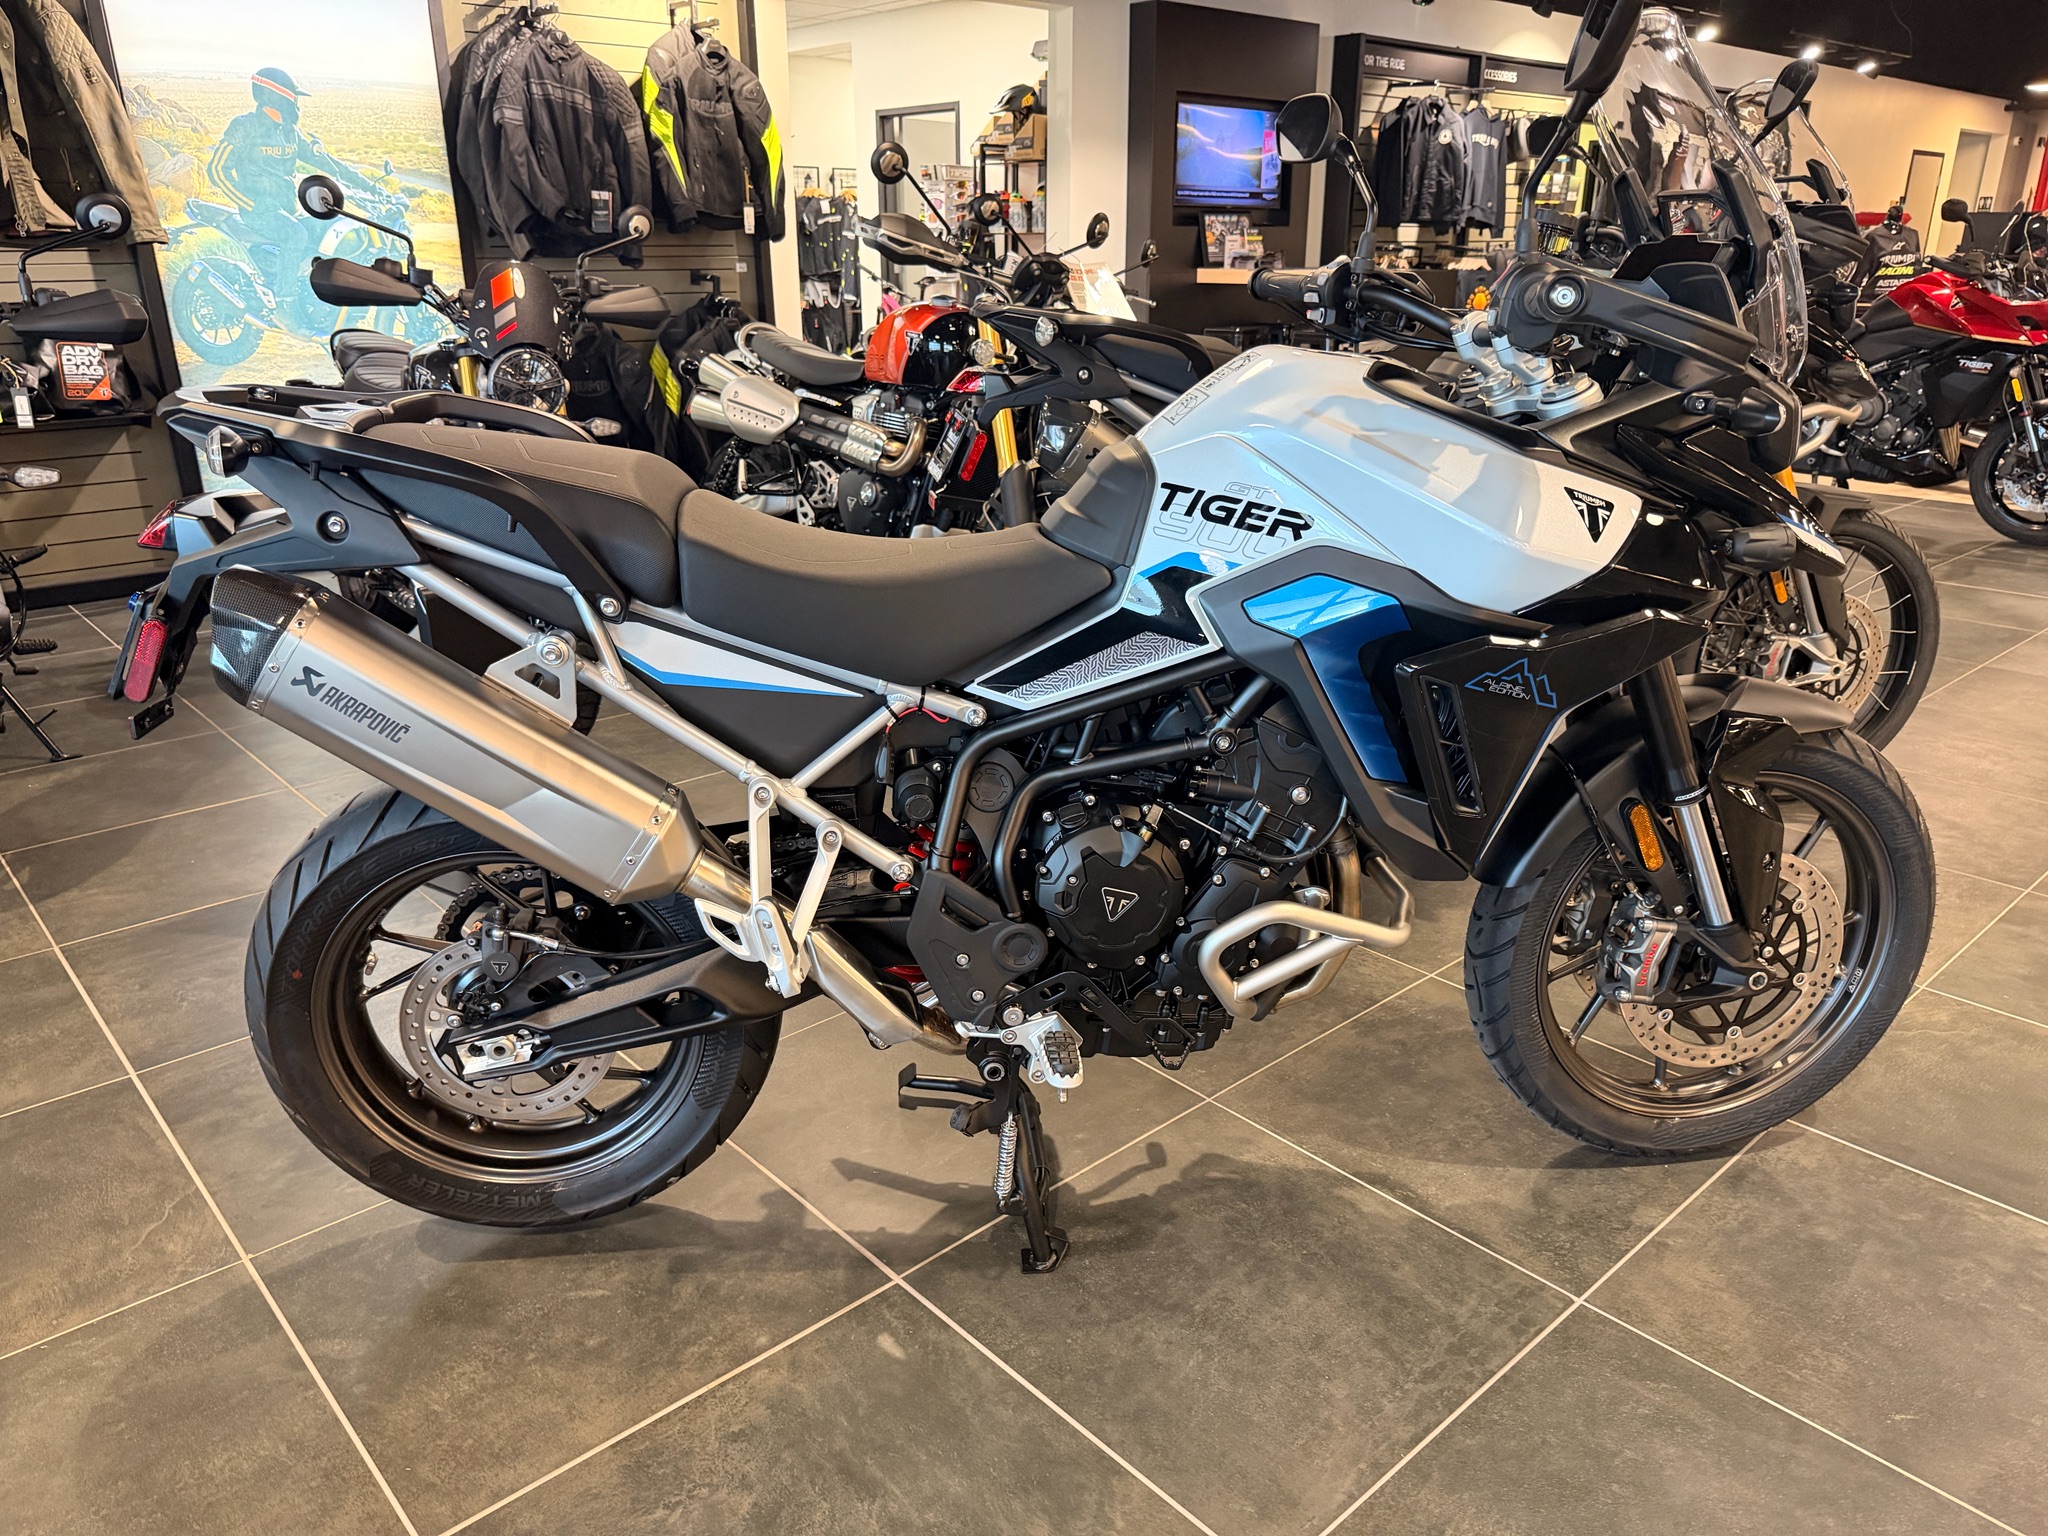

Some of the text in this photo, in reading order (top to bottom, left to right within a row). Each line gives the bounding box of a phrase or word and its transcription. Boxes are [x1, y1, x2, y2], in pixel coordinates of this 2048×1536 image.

[1364, 55, 1405, 70] OR THE RIDE
[1484, 69, 1517, 83] CCESSORIES
[61, 345, 101, 356] ADV
[62, 355, 101, 366] DRY
[1959, 359, 1993, 370] TIGER
[63, 365, 104, 376] BAG
[67, 389, 88, 397] 20L
[1223, 481, 1274, 499] GT
[1573, 491, 1606, 508] TRIUMPH
[1160, 482, 1315, 542] TIGER
[1483, 678, 1526, 693] ALPINE
[1488, 684, 1531, 700] EDITION
[1636, 943, 1659, 987] brembo
[406, 1173, 542, 1209] METZELER
